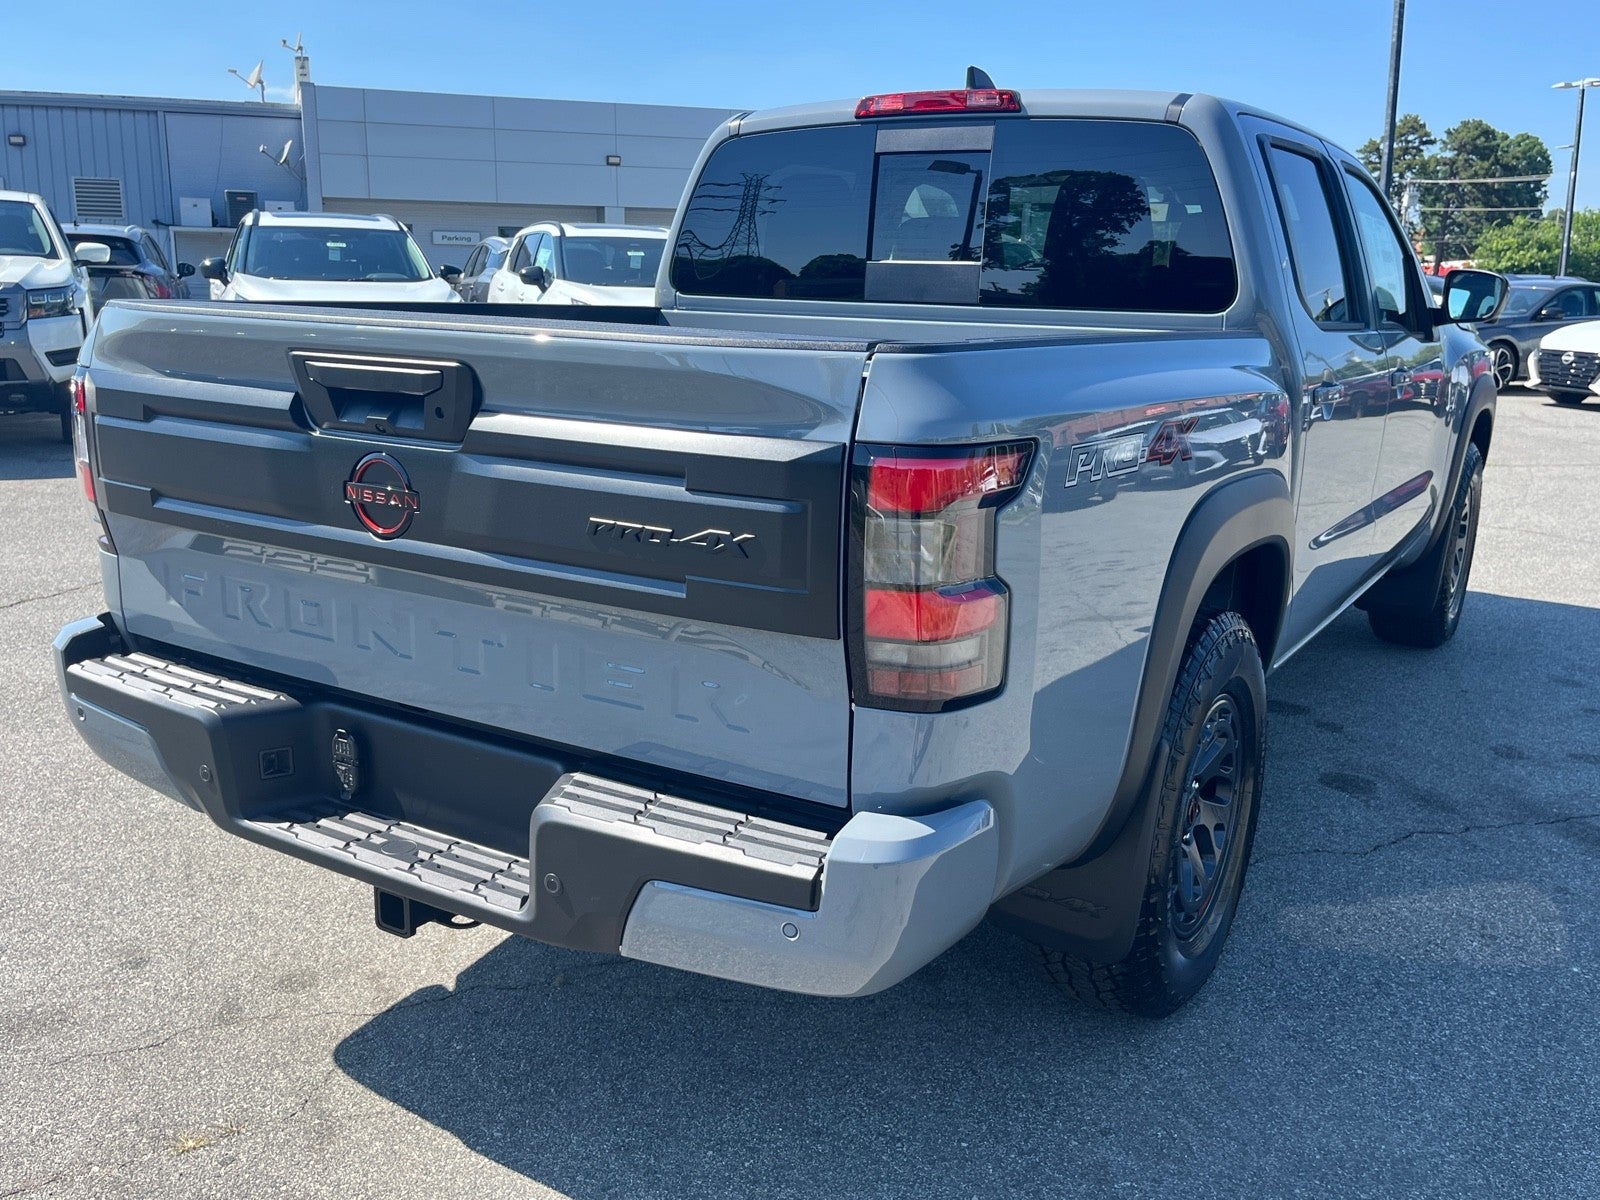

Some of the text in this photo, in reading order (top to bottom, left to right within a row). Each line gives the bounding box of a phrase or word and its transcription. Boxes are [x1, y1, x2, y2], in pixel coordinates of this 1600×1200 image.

[441, 234, 472, 243] Parking
[1064, 416, 1200, 488] PRO-4X
[346, 485, 418, 509] NISSAN
[585, 516, 756, 559] PRO-4X
[163, 562, 751, 734] FRONTIER
